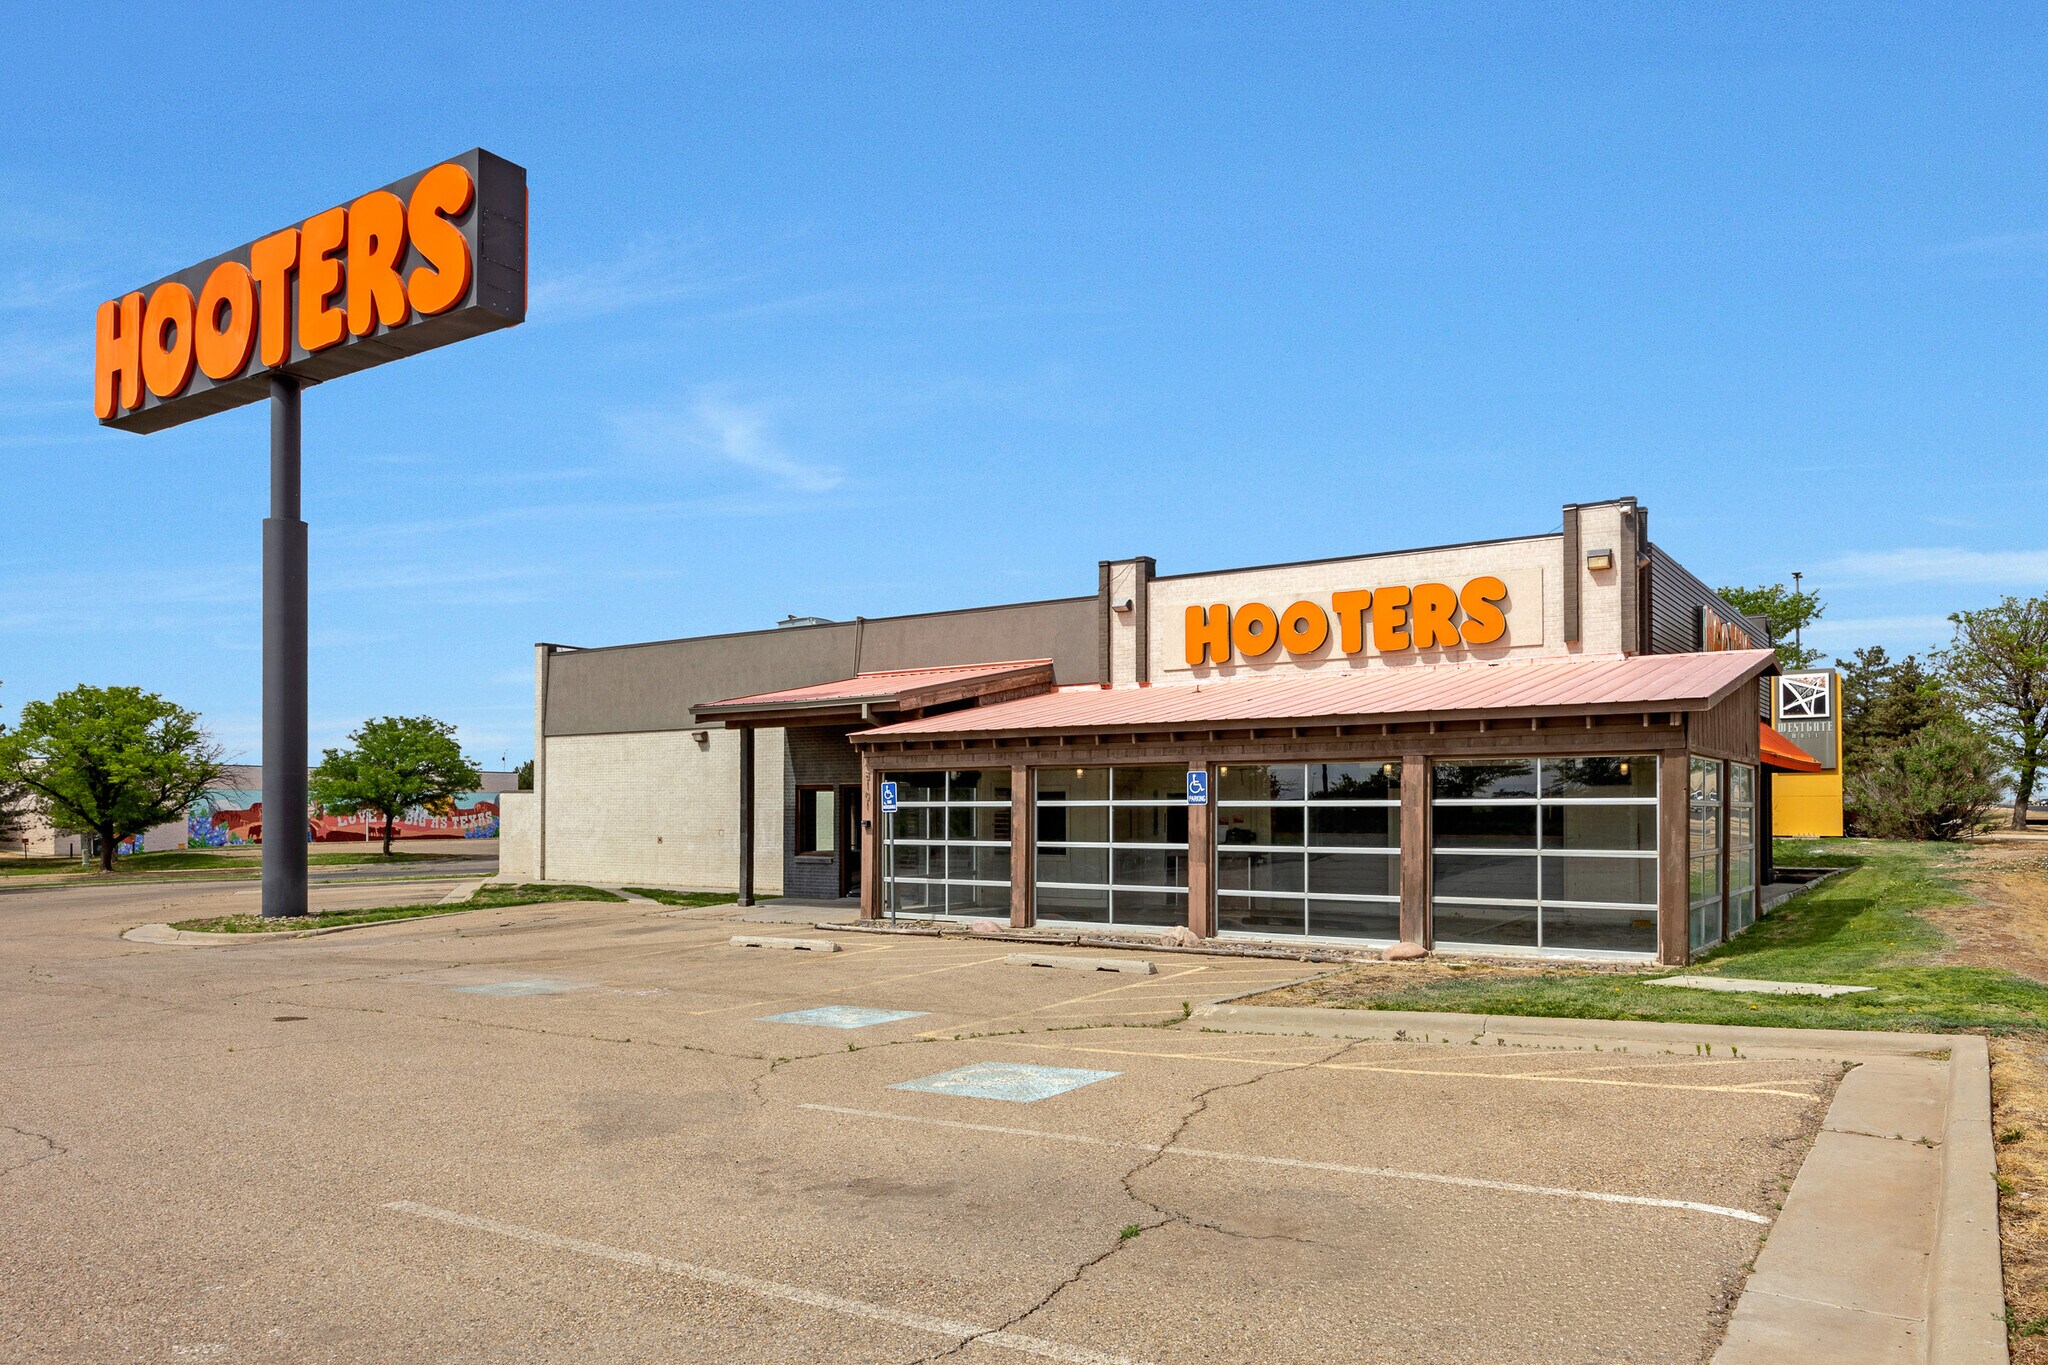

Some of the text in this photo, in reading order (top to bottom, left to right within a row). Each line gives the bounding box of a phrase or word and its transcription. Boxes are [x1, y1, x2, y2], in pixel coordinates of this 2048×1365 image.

[95, 163, 475, 419] HOOTERS
[1185, 576, 1507, 664] HOOTERS
[1777, 721, 1833, 733] WESTGATE
[1189, 795, 1206, 803] PARKING
[337, 808, 377, 827] LOVE
[404, 811, 427, 827] BIG
[430, 815, 448, 829] AS
[452, 810, 493, 829] TEXAS
